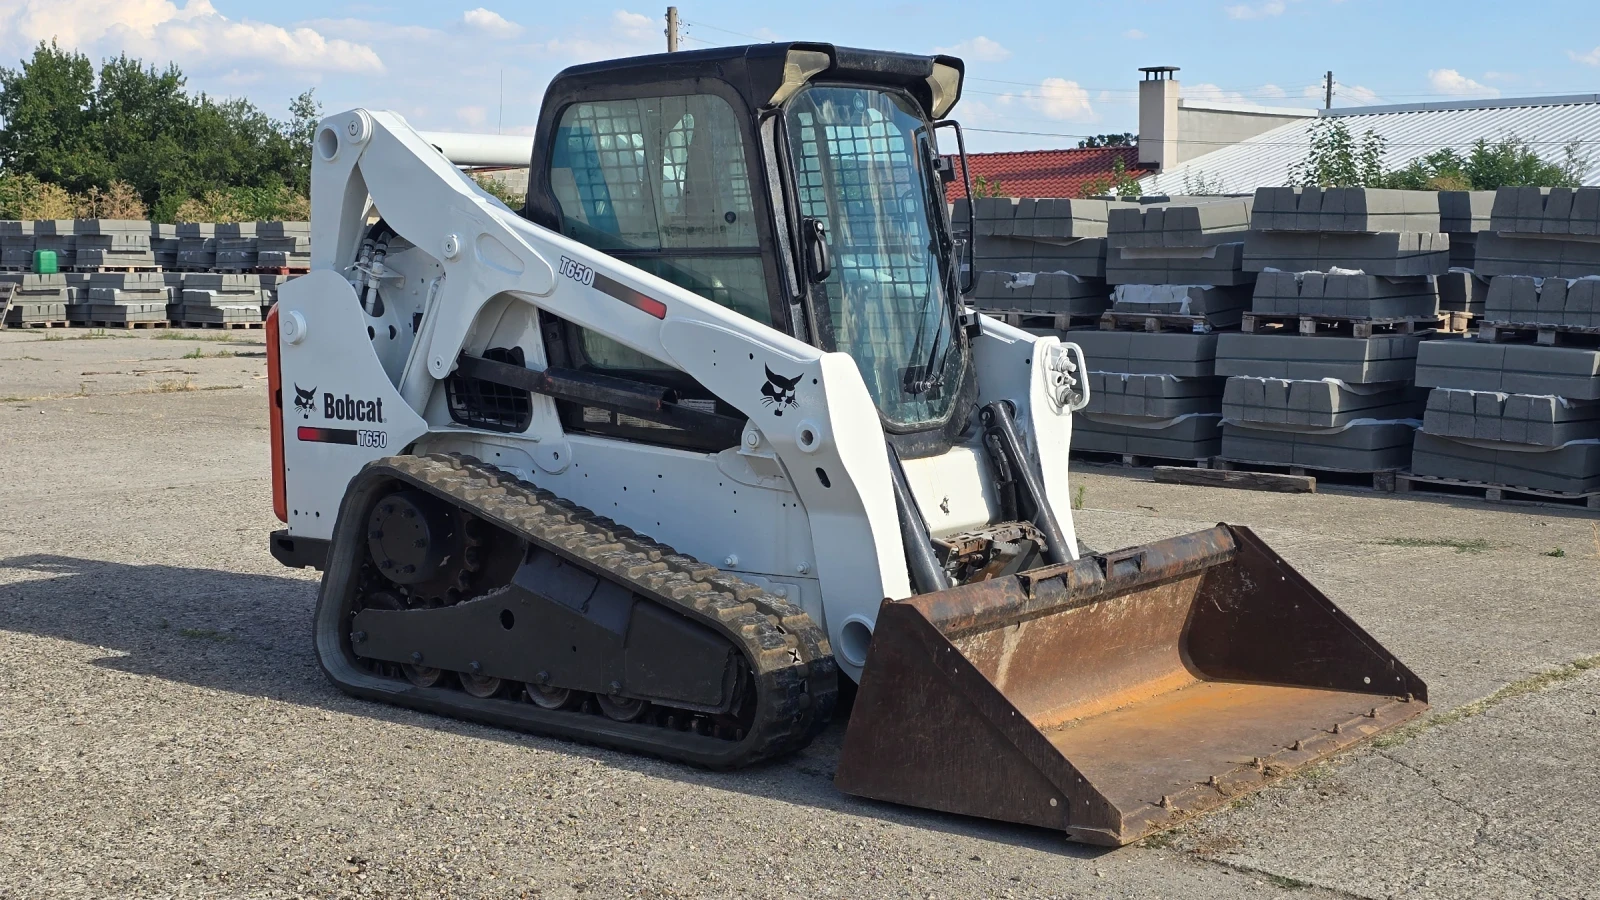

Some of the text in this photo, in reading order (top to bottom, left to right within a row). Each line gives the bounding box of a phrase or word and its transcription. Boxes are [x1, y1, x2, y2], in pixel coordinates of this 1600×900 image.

[559, 255, 594, 286] T650
[323, 392, 383, 423] Bobcat
[358, 430, 387, 448] T650
